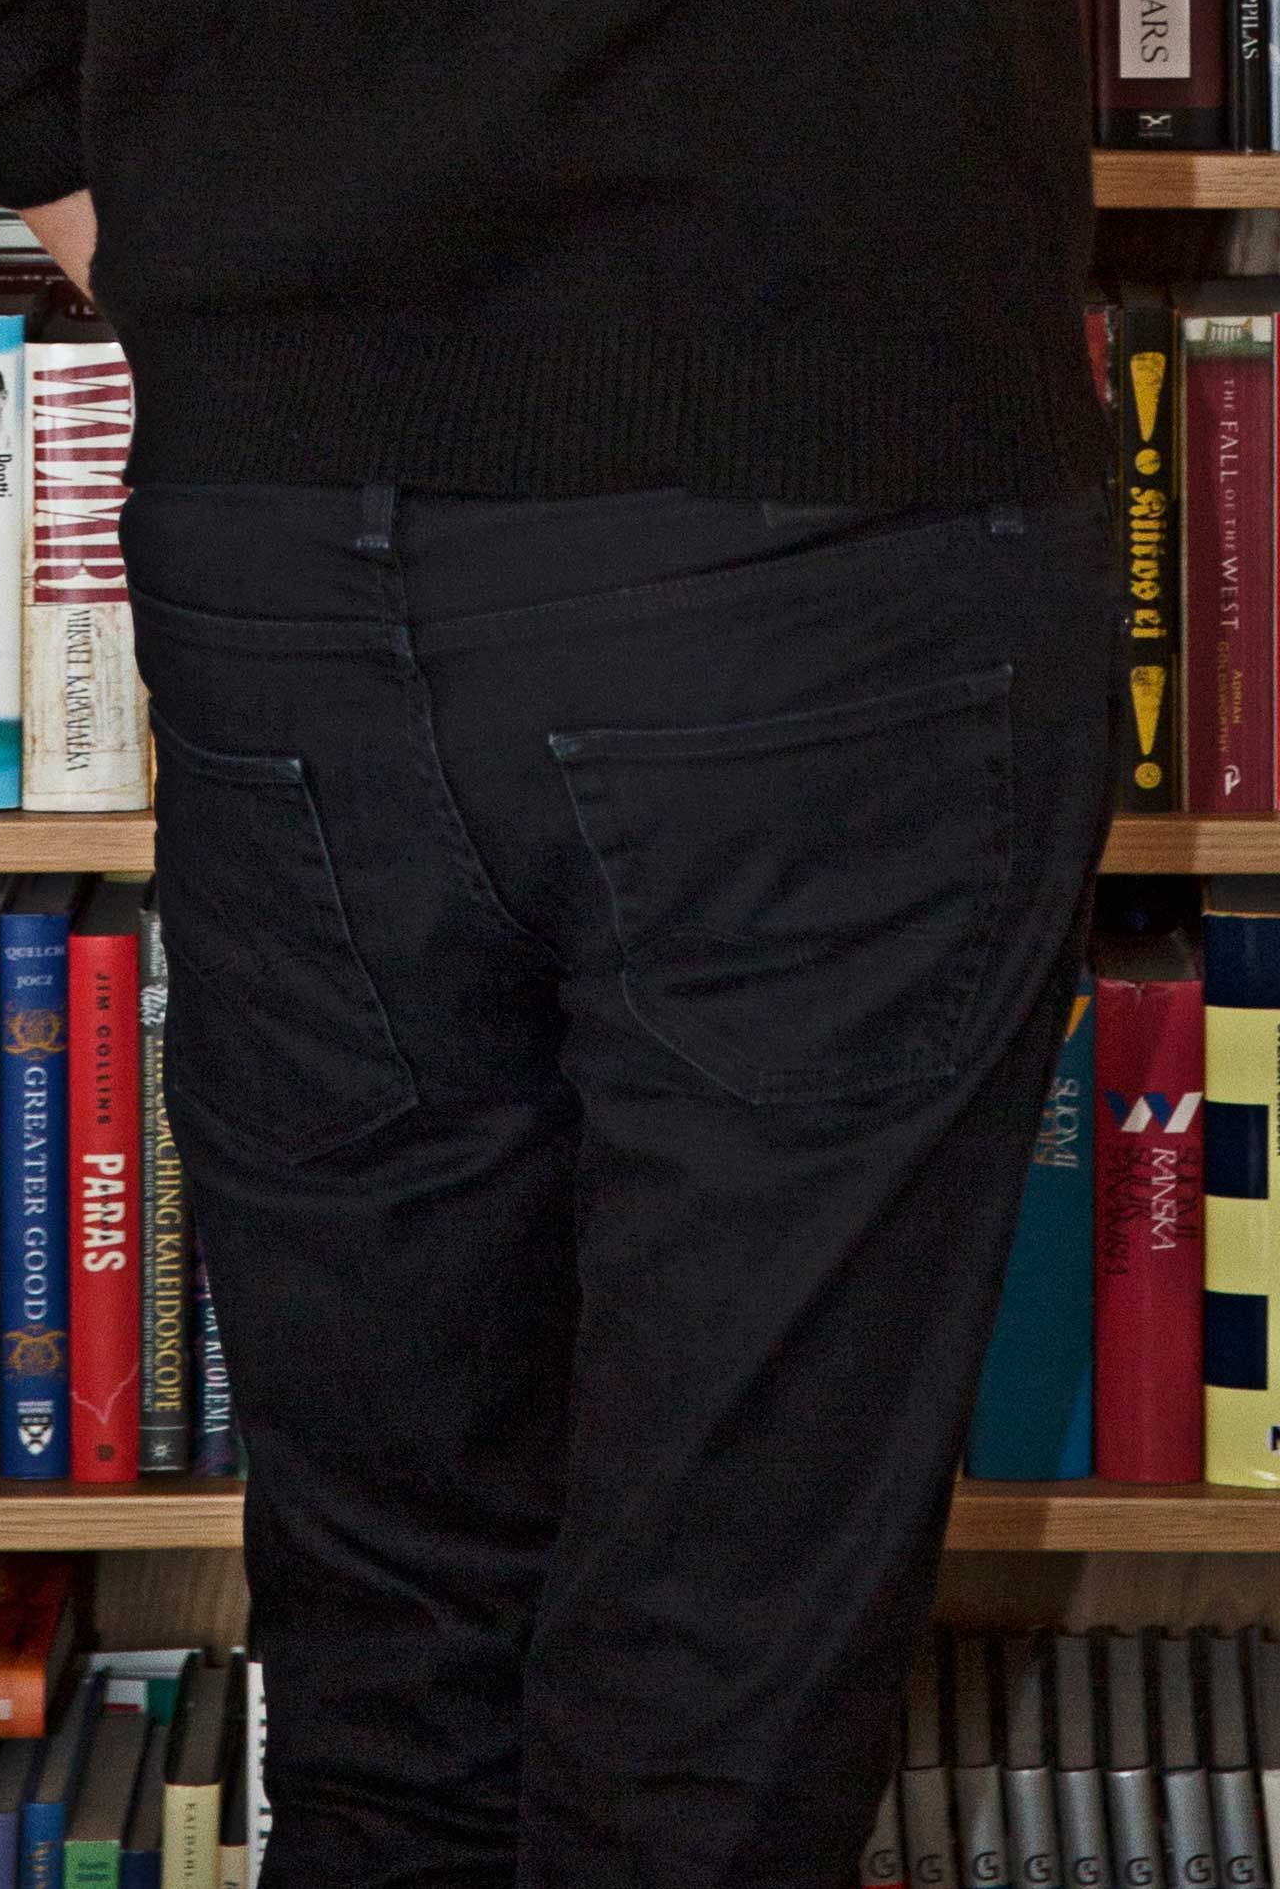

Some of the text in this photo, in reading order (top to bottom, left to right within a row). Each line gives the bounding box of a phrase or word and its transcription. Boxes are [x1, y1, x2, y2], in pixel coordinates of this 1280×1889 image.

[22, 1066, 46, 1321] GREATER GOOD
[1151, 1148, 1176, 1250] RANSKA
